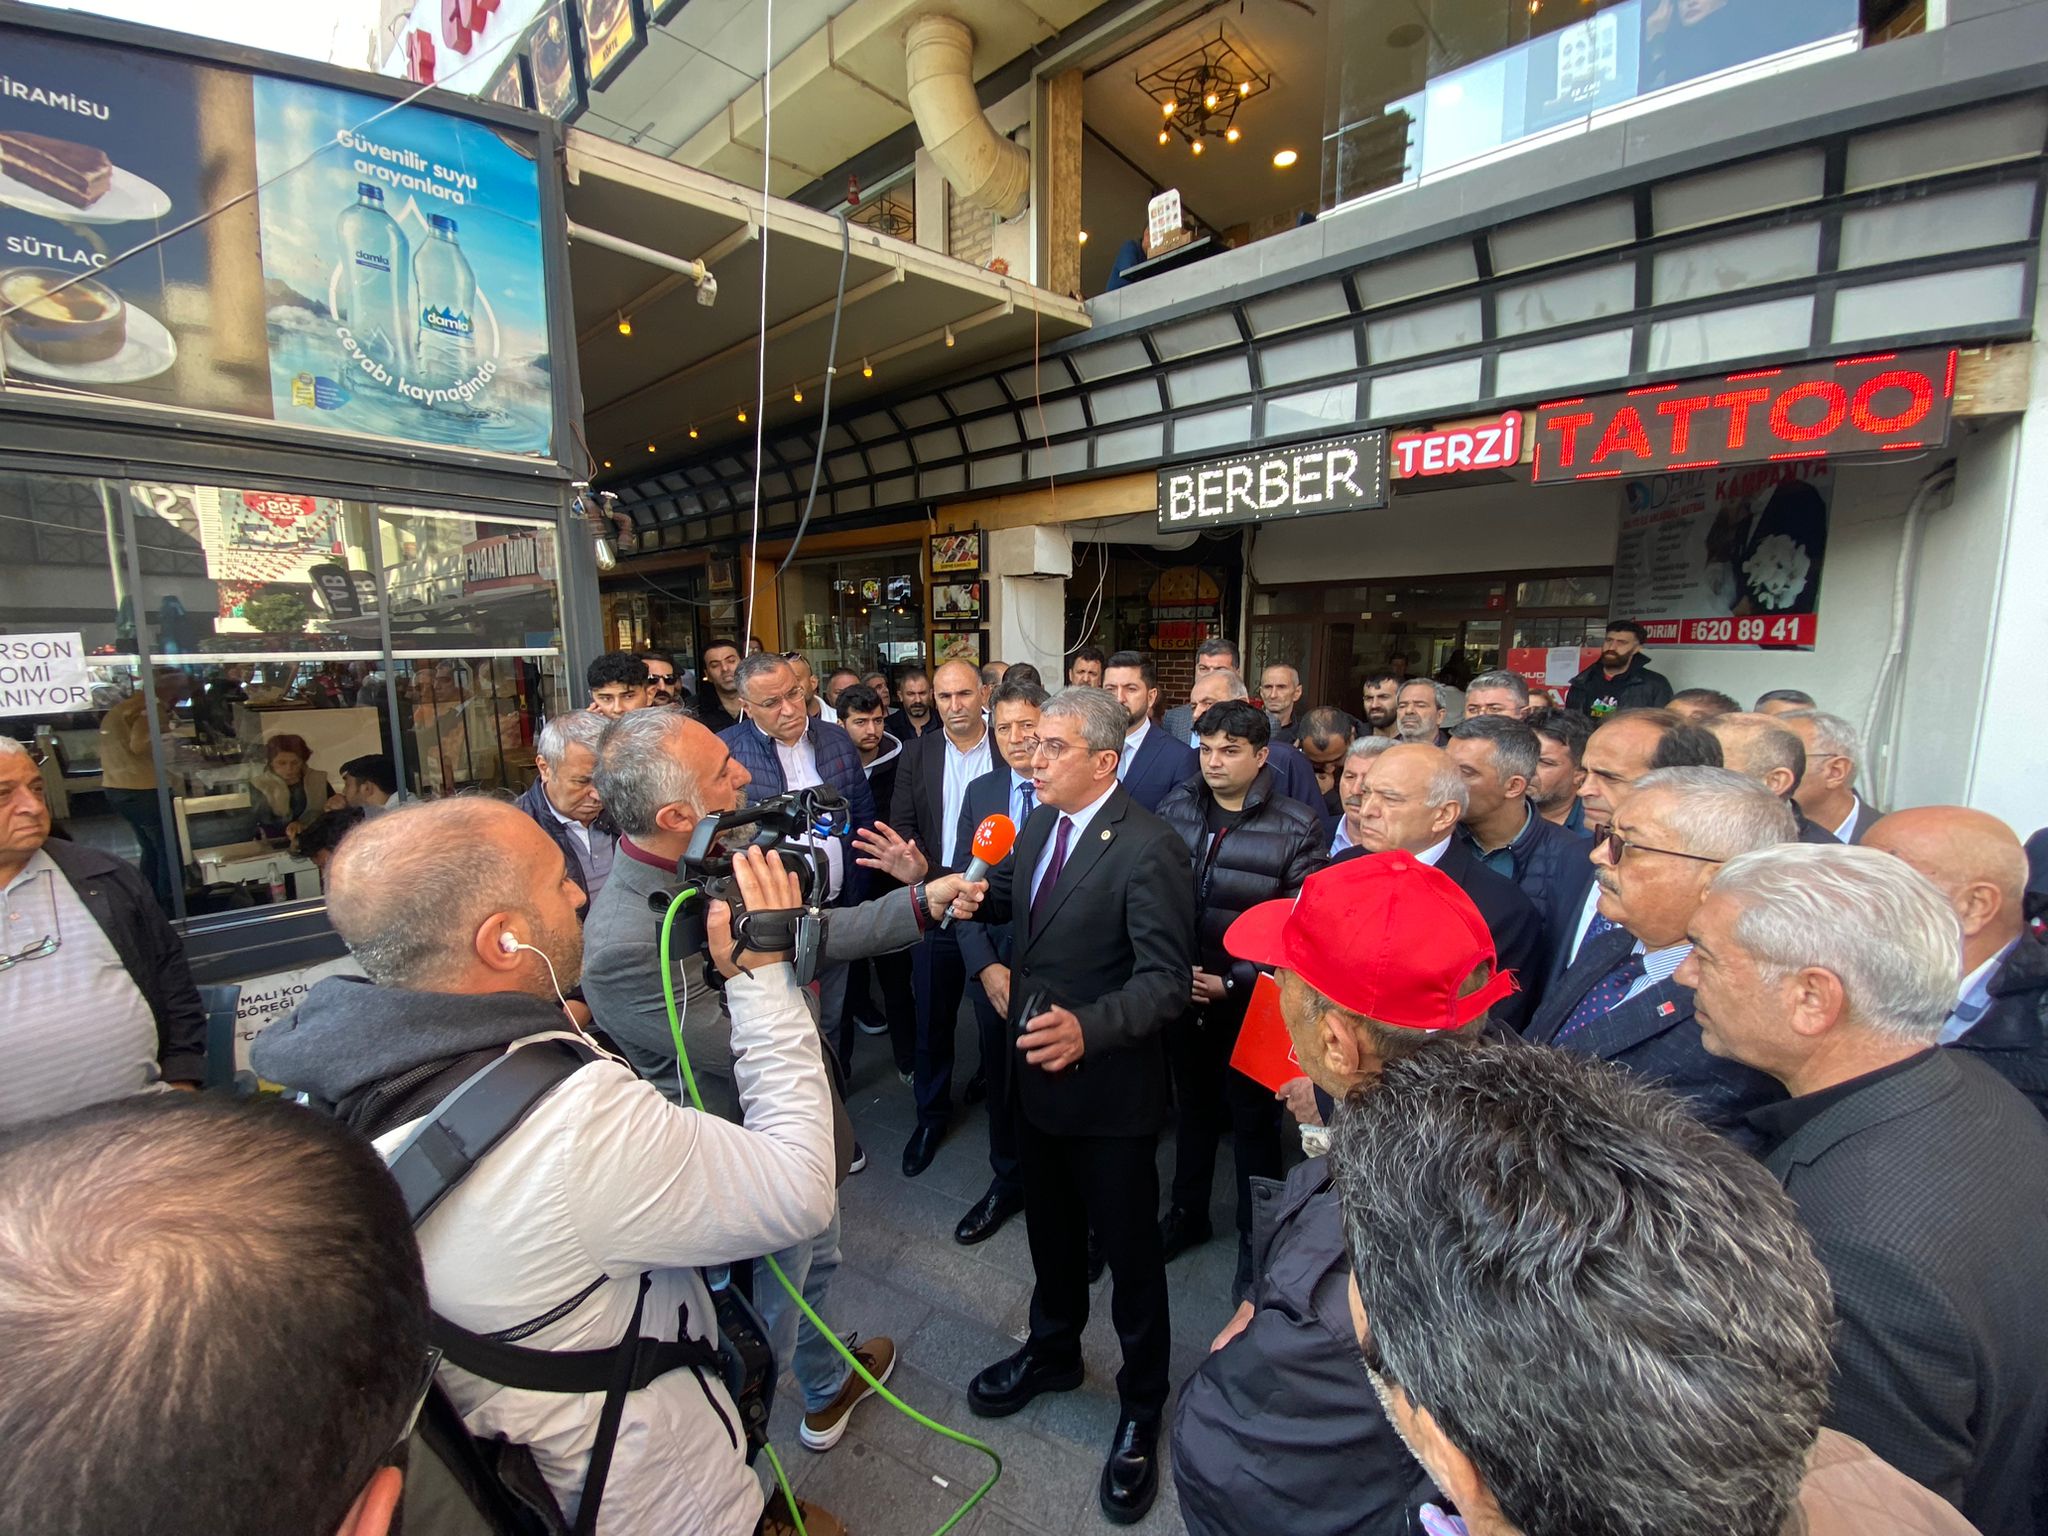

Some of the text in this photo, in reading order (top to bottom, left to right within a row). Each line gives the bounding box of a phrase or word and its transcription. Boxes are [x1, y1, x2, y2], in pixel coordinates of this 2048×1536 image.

[0, 75, 110, 120] İRAMİSU
[336, 129, 477, 189] Güvenilir suyu
[354, 159, 465, 205] arayanlara
[355, 250, 390, 266] damla
[427, 312, 469, 332] damla
[336, 326, 497, 407] cevabı kaynağında
[1547, 370, 1934, 467] TATTOO
[1397, 417, 1515, 473] TERZİ
[1169, 448, 1364, 521] BERBER
[1643, 623, 1678, 639] DİRİM
[1696, 619, 1732, 641] 620
[1737, 618, 1765, 641] 89
[1770, 617, 1800, 641] 41
[237, 996, 295, 1019] BÖREĞİ
